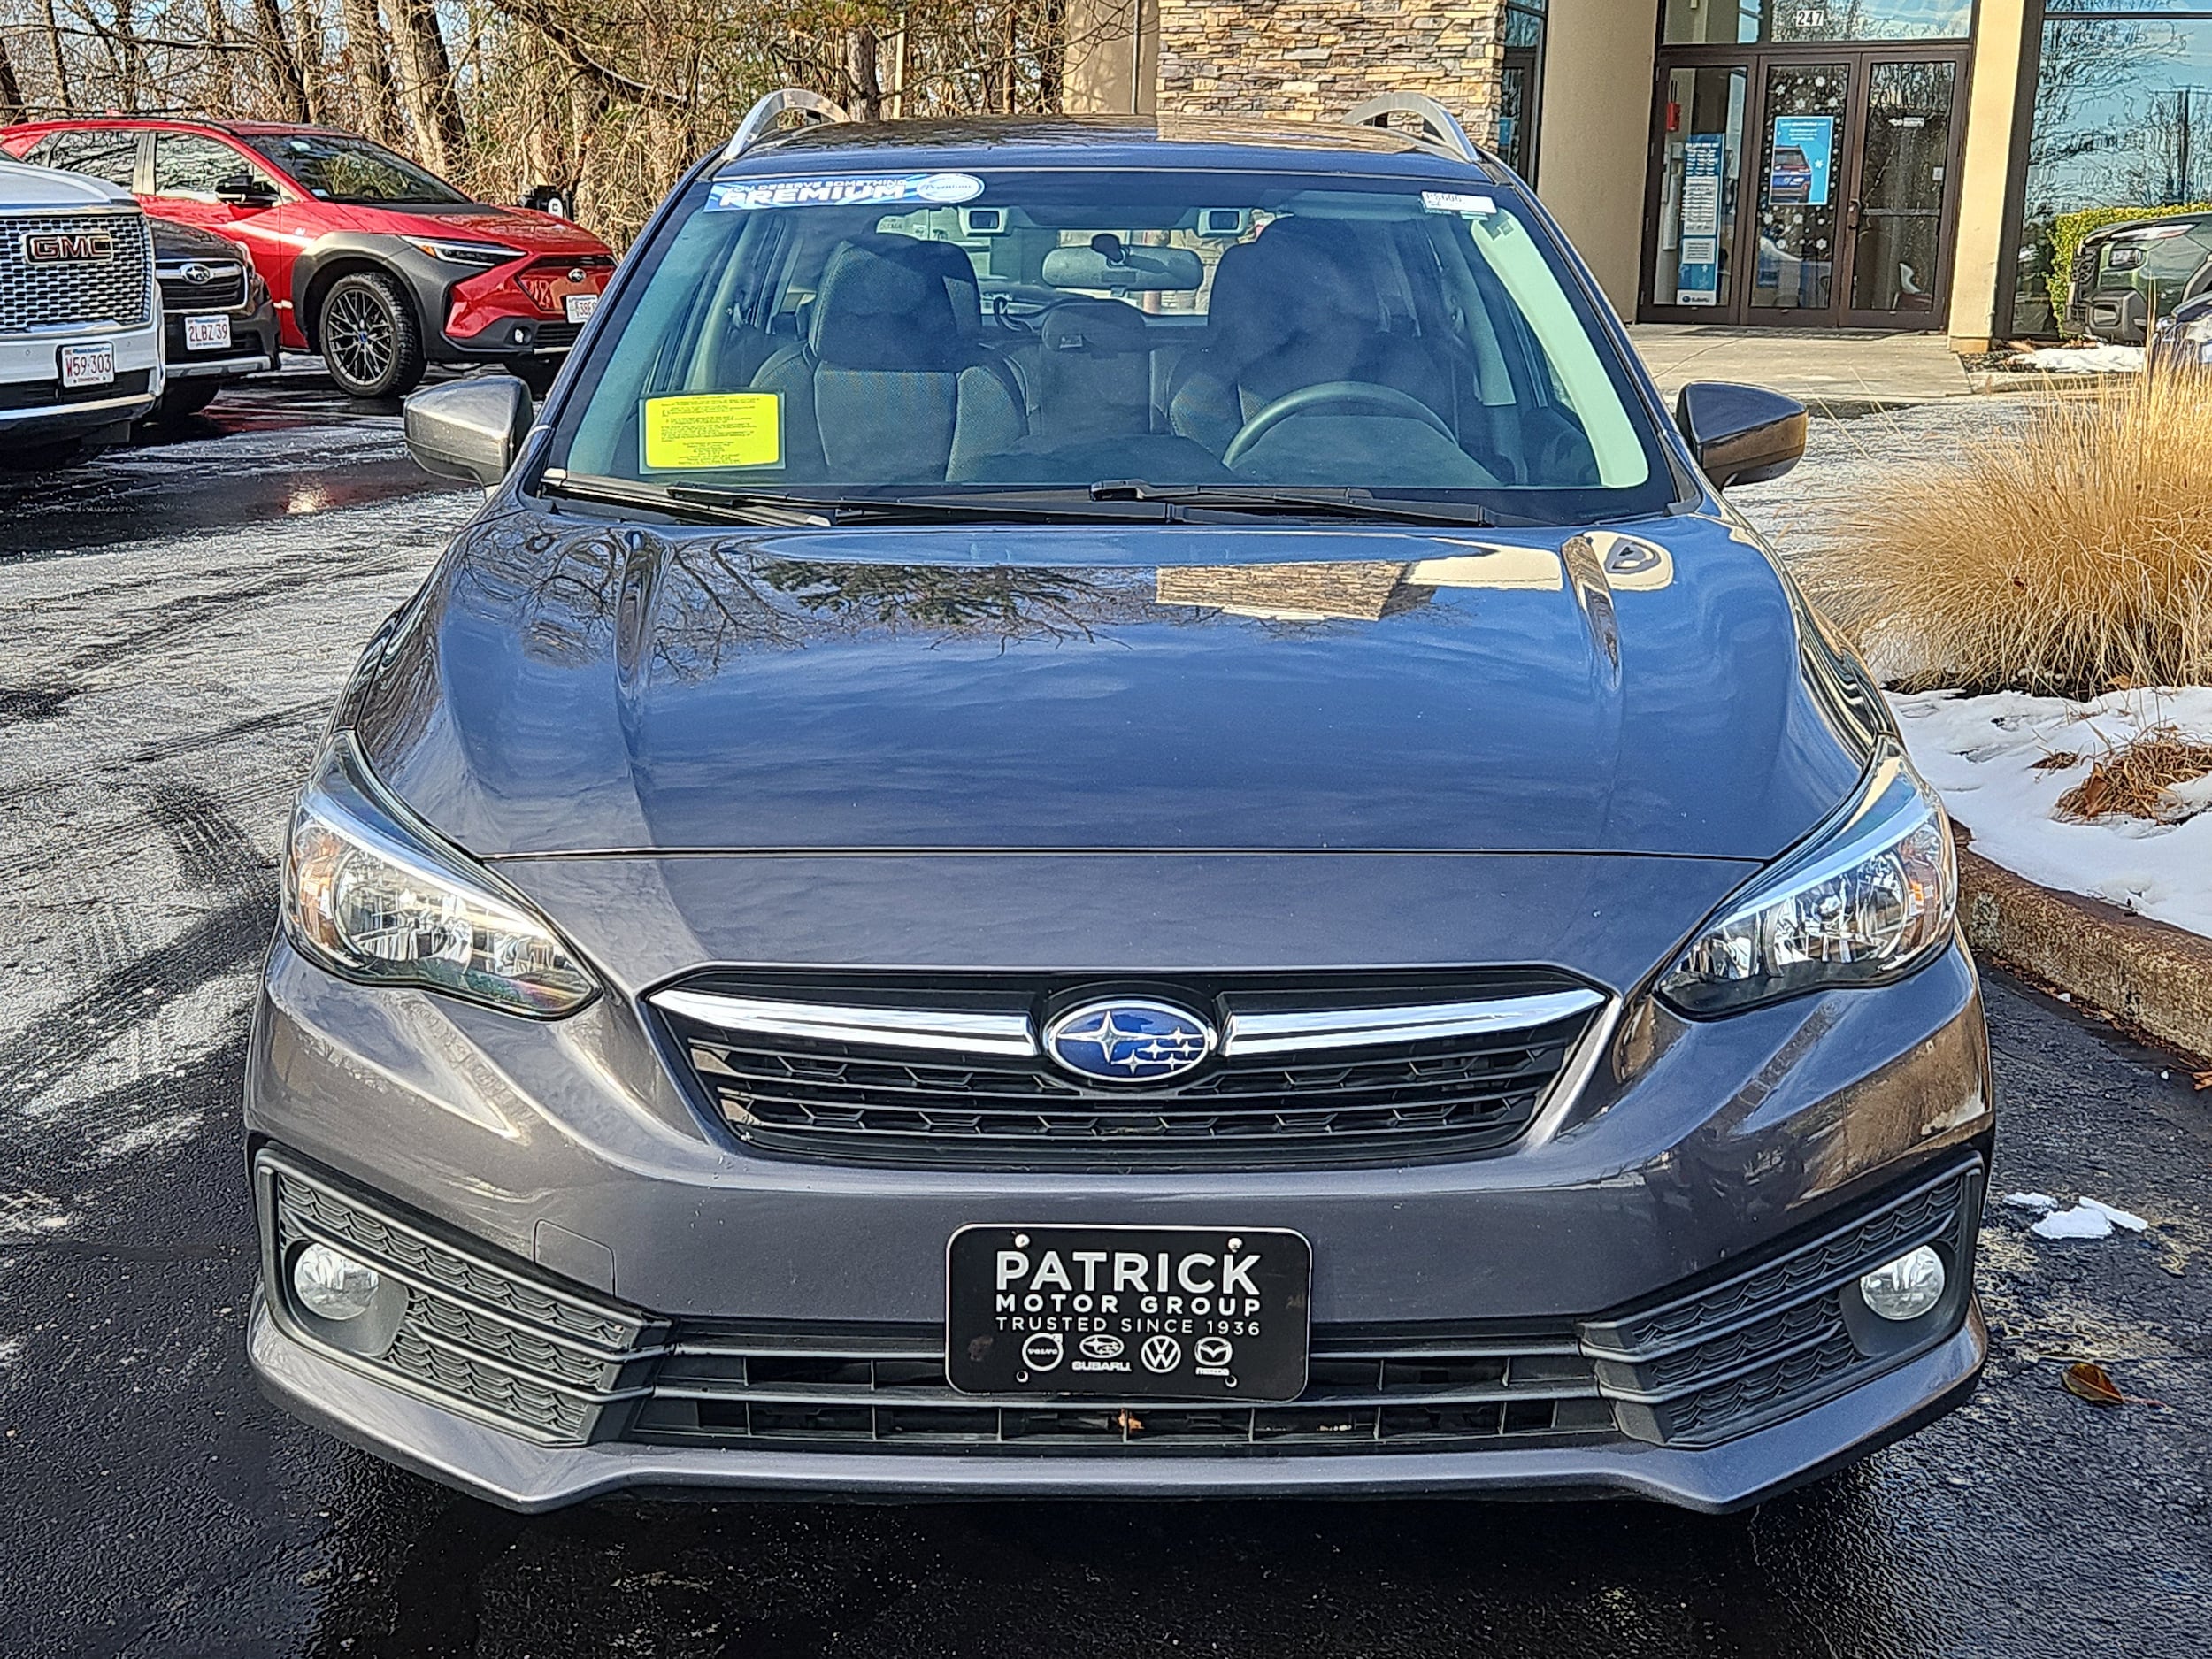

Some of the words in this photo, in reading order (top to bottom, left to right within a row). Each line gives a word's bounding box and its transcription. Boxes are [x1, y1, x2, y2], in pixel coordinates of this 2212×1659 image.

[1798, 11, 1823, 25] 247
[825, 179, 906, 188] SOMETHING
[719, 184, 906, 207] PREMIUM
[32, 235, 112, 259] GMC
[996, 1250, 1261, 1295] PATRICK
[995, 1294, 1118, 1314] MOTOR
[1140, 1295, 1261, 1317] GROUP
[995, 1316, 1107, 1332] TRUSTED
[1120, 1317, 1194, 1334] SINCE
[1206, 1319, 1261, 1336] 1936
[1071, 1361, 1132, 1371] SUBARU
